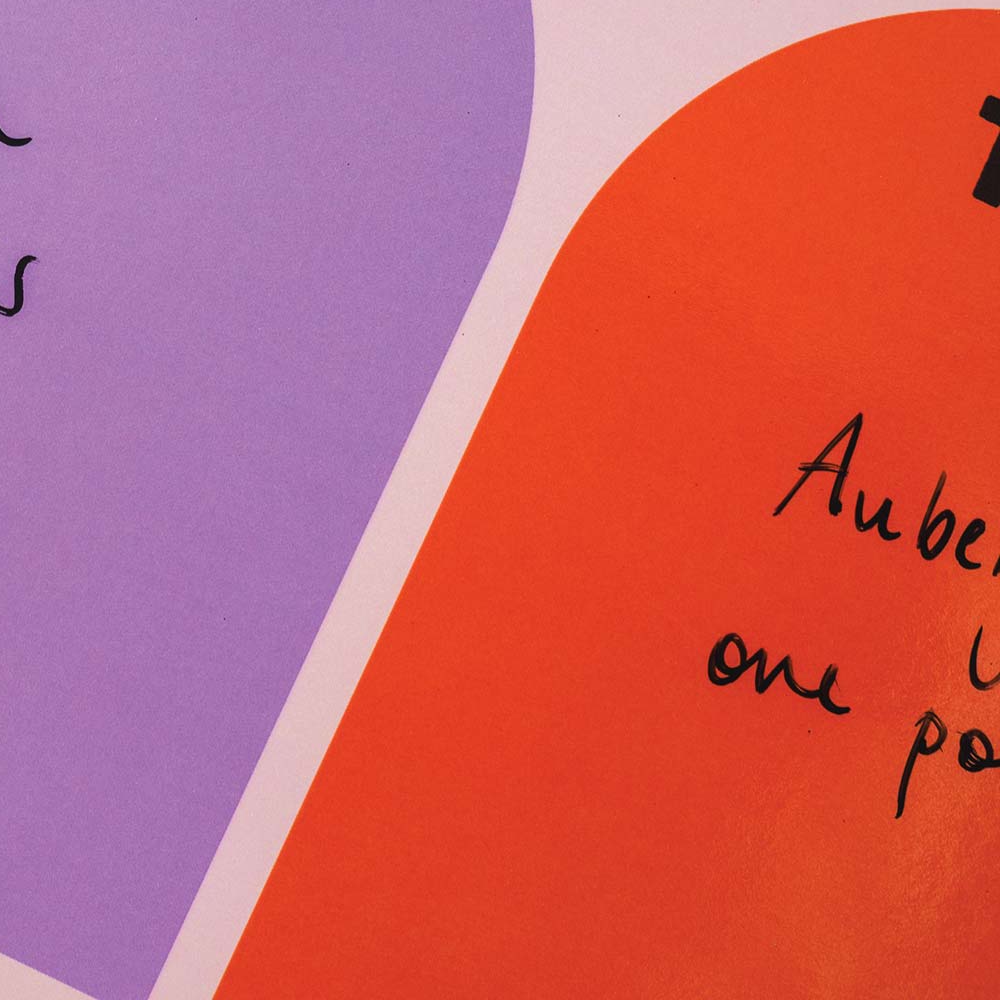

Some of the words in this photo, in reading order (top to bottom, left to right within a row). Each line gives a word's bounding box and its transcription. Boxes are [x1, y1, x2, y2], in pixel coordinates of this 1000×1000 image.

[772, 412, 1000, 577] Aube
[707, 632, 852, 716] one
[895, 708, 1000, 820] po
